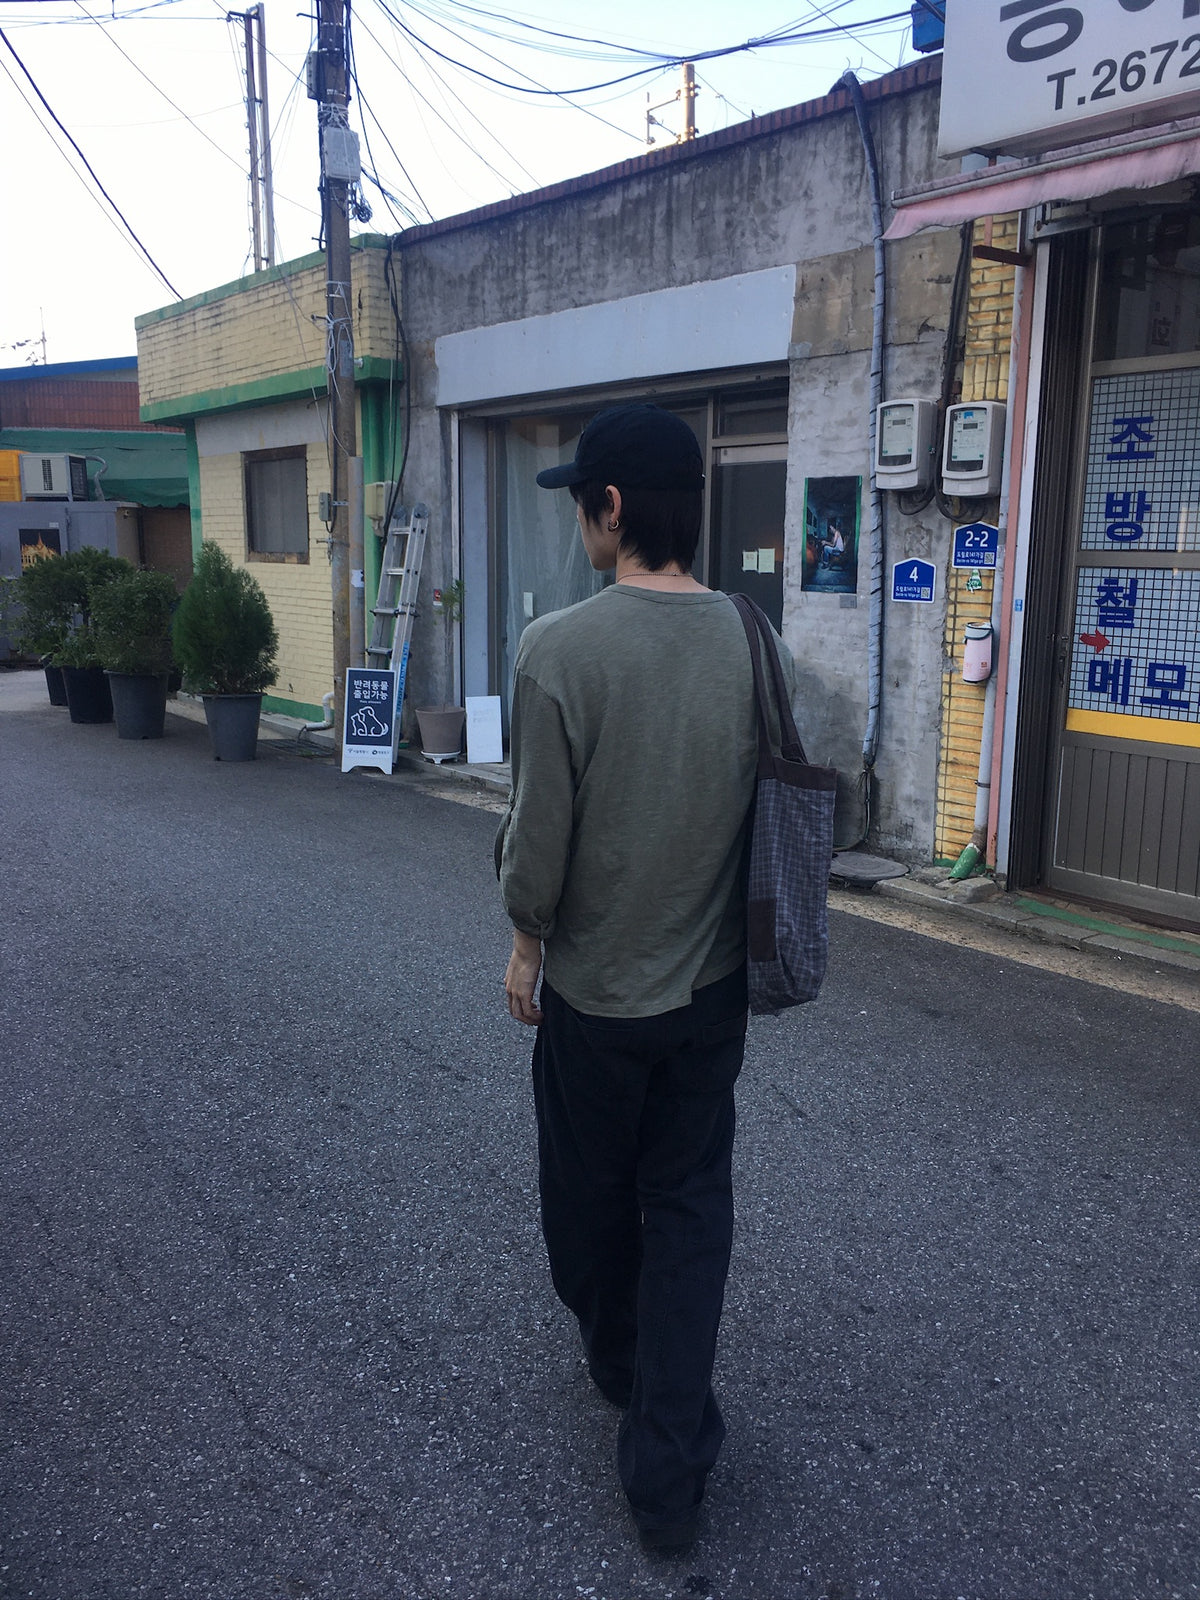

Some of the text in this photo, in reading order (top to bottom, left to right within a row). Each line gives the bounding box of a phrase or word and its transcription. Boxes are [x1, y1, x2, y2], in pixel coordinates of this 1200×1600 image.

[965, 530, 989, 548] 2-2
[909, 566, 919, 583] 4
[353, 679, 389, 691] 반려동물
[353, 689, 389, 700] 출입가능
